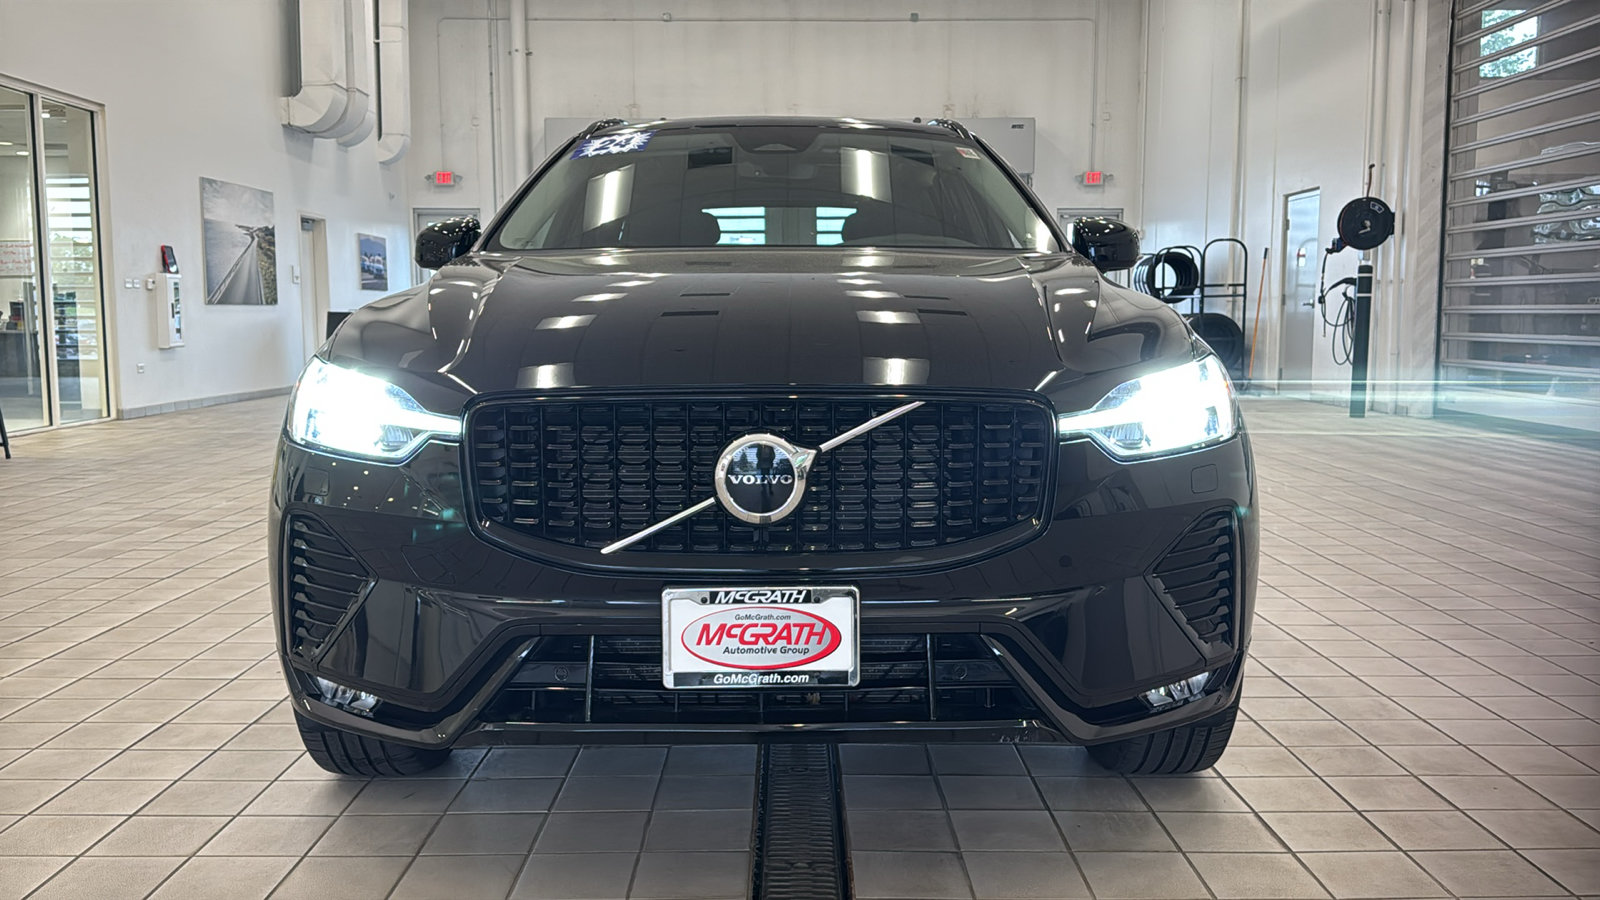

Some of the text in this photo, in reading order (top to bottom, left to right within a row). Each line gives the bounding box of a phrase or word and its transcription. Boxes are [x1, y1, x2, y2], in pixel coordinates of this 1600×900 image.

[436, 171, 452, 184] EXIT
[1086, 171, 1101, 184] EXIT
[728, 474, 793, 485] VOLVO
[735, 613, 791, 621] GoMcGrath.com
[723, 646, 810, 656] Automotive Group
[713, 672, 809, 685] GoMcGrath.com
